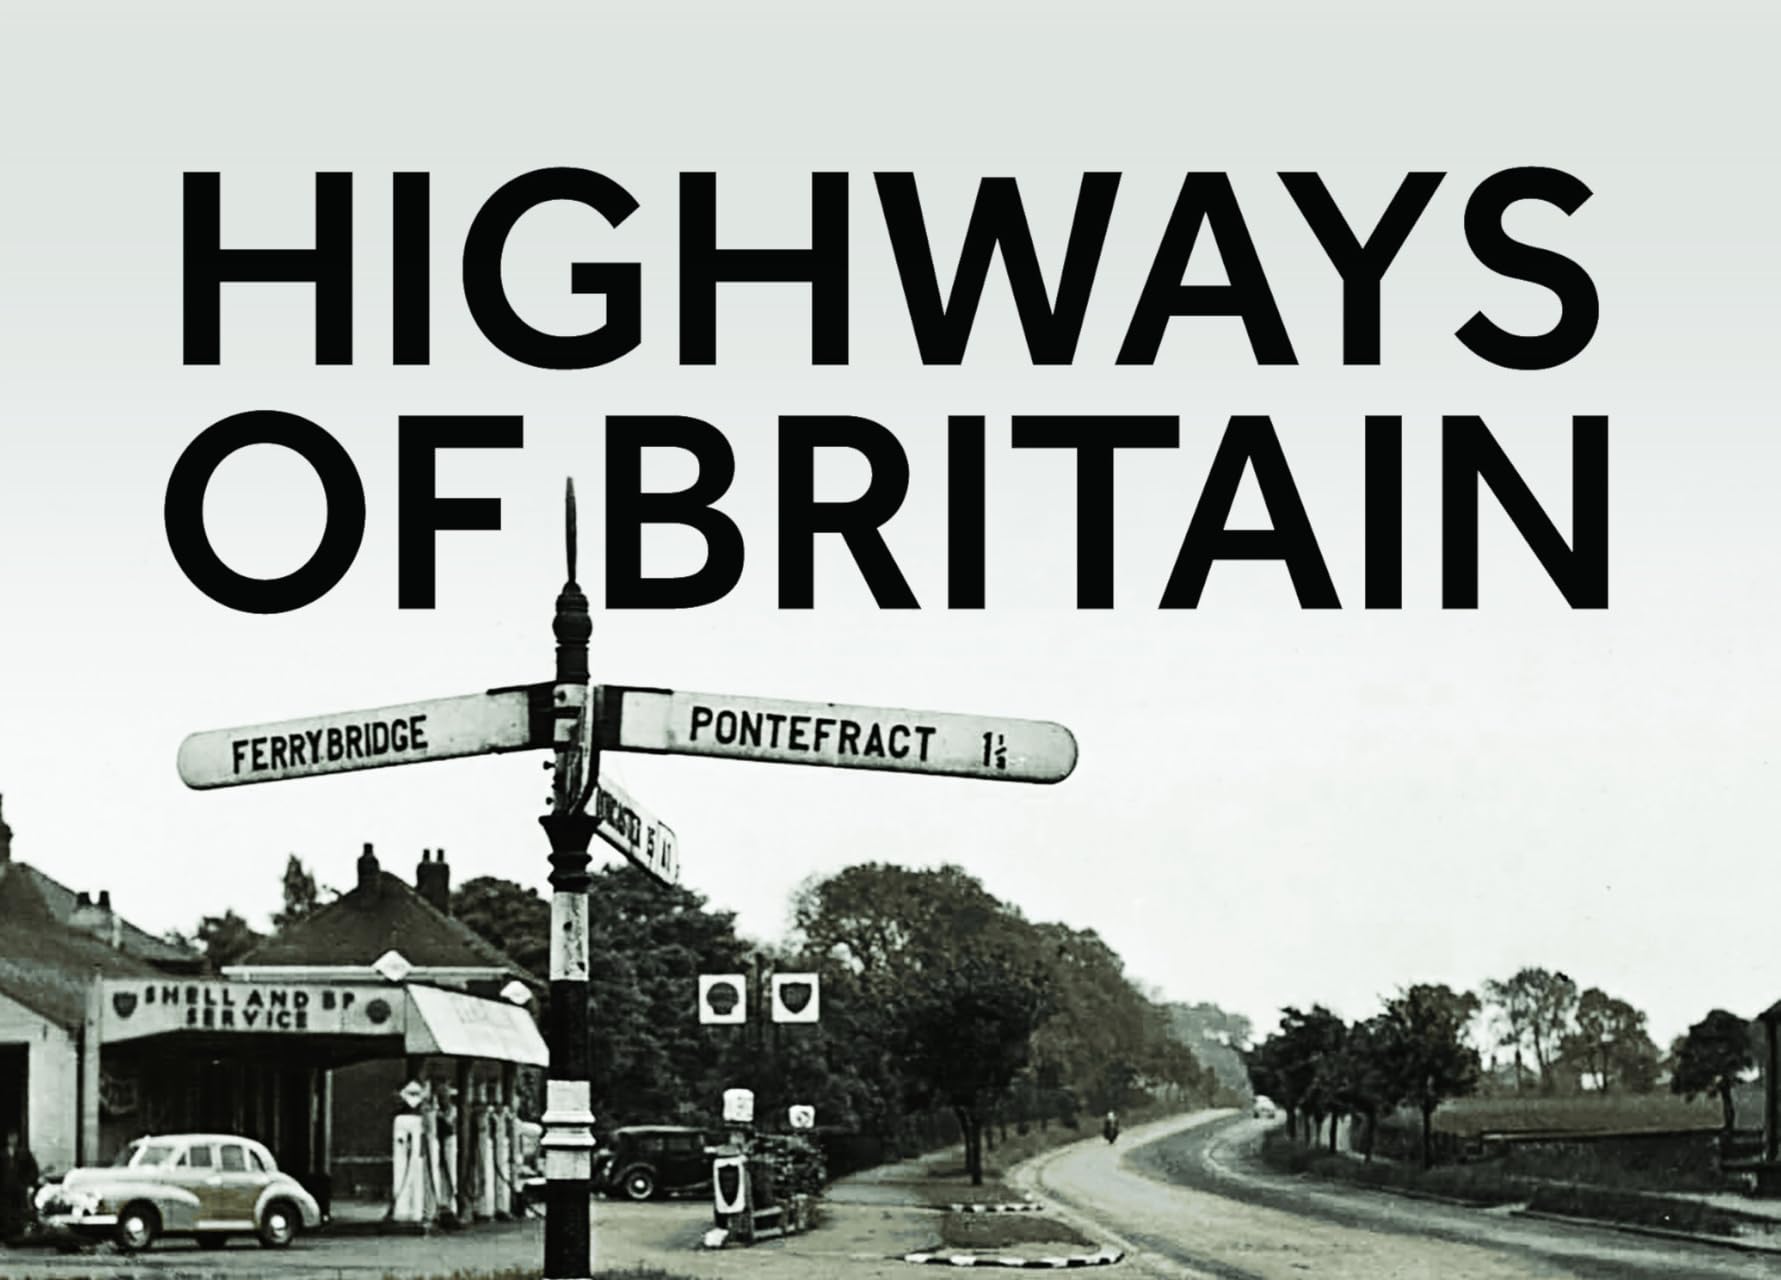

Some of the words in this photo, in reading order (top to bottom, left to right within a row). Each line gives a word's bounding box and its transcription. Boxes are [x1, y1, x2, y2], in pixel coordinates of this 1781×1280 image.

[232, 714, 428, 774] FERRYBRIDGE
[689, 706, 936, 761] PONTEFRACT
[145, 985, 235, 1006] SHELL
[245, 988, 310, 1009] AND
[322, 990, 355, 1010] BP
[186, 1007, 308, 1029] SERVICE
